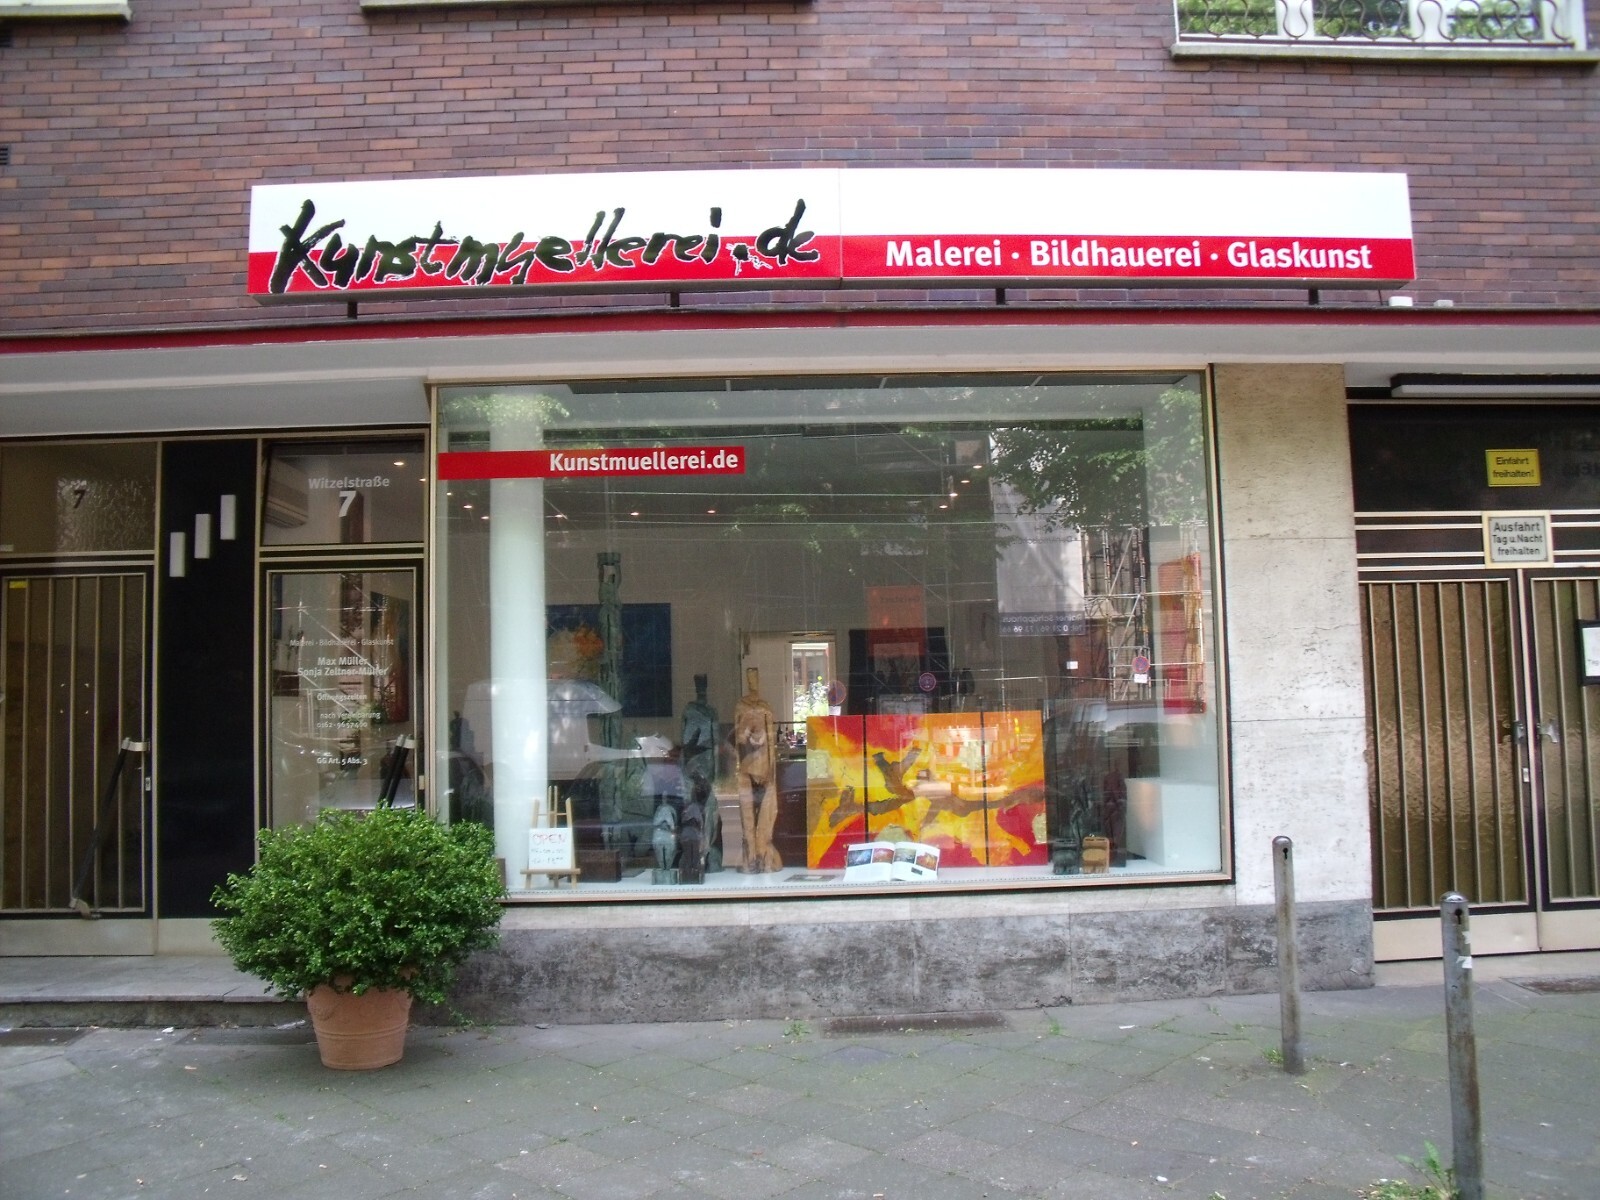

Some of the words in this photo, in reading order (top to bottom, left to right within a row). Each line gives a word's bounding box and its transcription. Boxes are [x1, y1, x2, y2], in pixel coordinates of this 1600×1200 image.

[269, 199, 820, 294] Kunstmuellerei.de
[885, 239, 1002, 268] Malerei
[1030, 239, 1201, 269] Bildhauerei
[1227, 241, 1373, 270] Glaskunst
[549, 449, 739, 472] Kunstmuellerei.de
[1496, 456, 1530, 466] Einfahrt
[1492, 470, 1535, 478] freihalten!
[308, 475, 390, 489] Witzelstraße
[73, 489, 87, 509] 7
[338, 490, 357, 518] 7
[1493, 521, 1541, 532] Ausfahrt
[1492, 534, 1508, 545] Tag
[1497, 546, 1540, 556] freihalten
[289, 639, 314, 647] Malerei
[361, 639, 394, 647] Glaskunst
[317, 657, 336, 666] Max
[339, 656, 368, 666] Müller
[298, 667, 322, 678] Sonja
[341, 758, 346, 766] 5
[362, 758, 368, 766] 3
